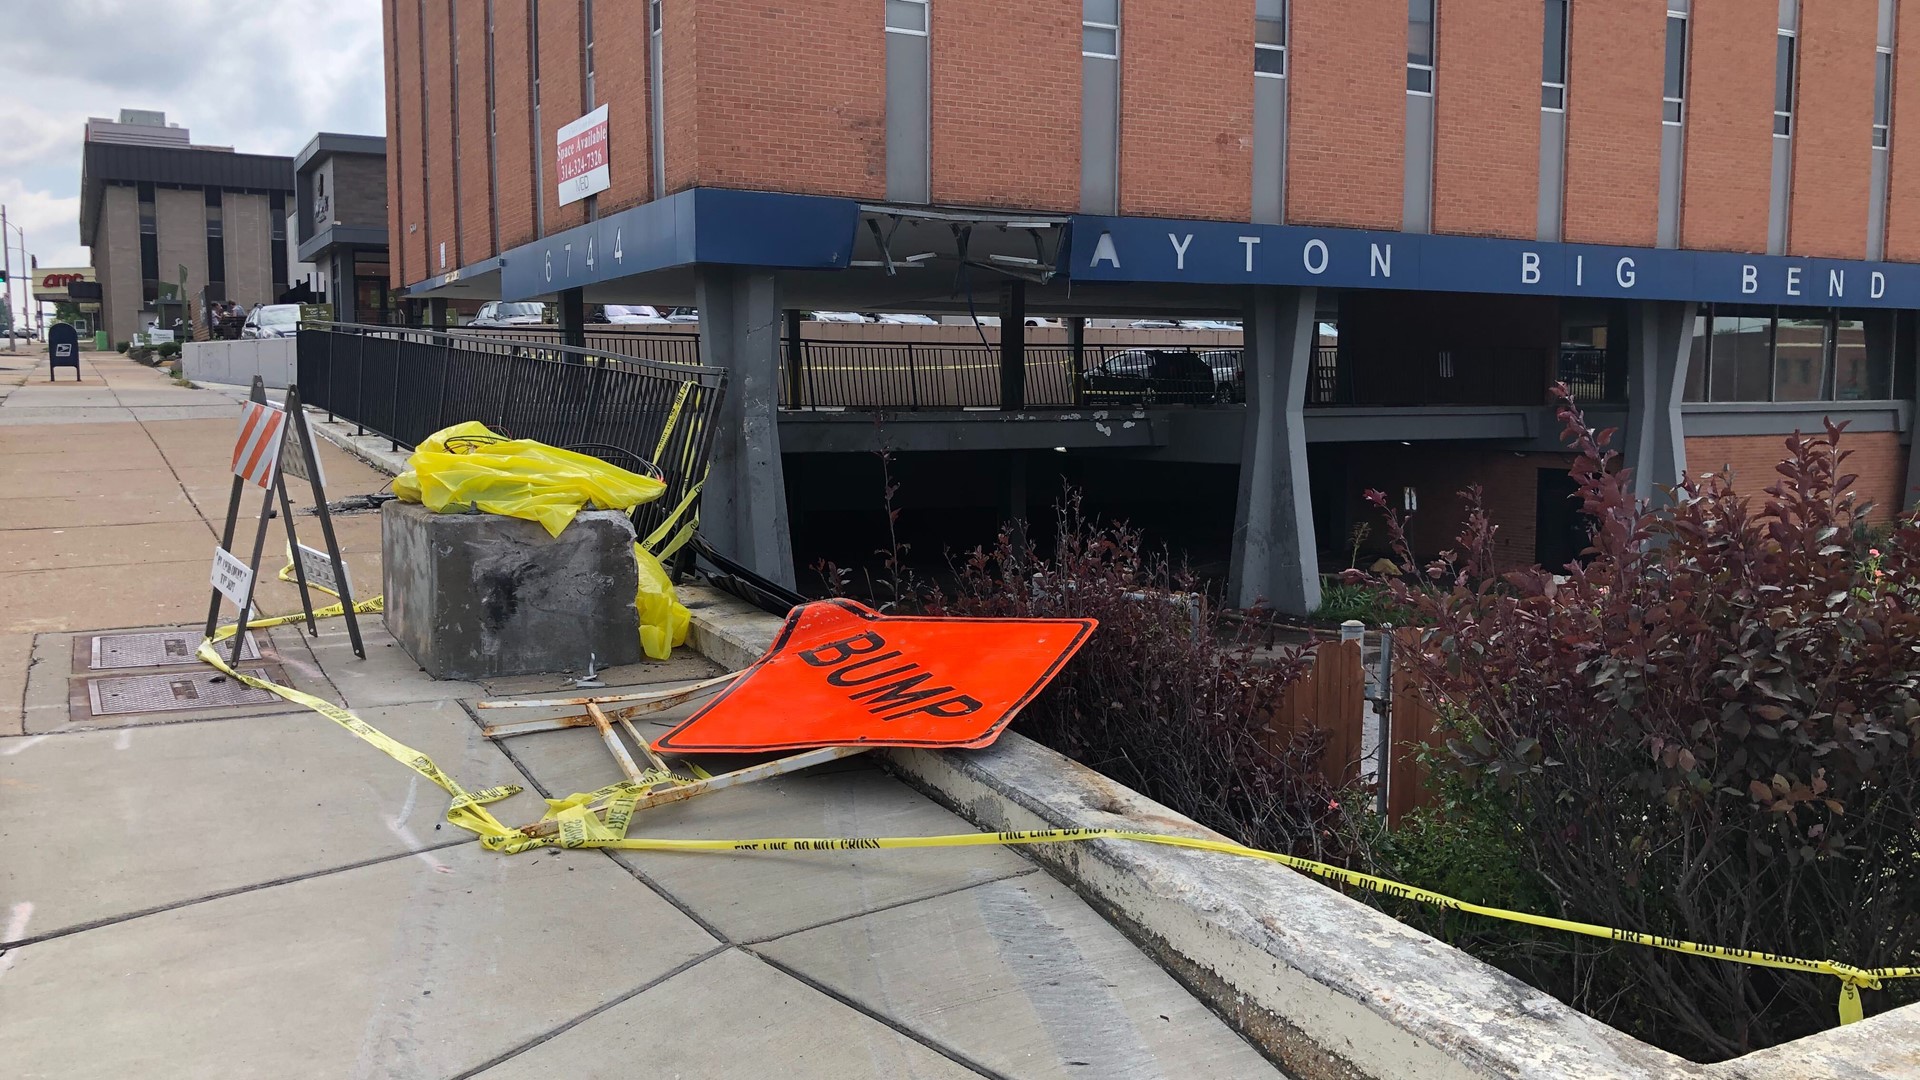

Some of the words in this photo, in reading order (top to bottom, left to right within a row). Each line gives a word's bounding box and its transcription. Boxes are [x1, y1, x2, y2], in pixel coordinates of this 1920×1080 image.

[557, 143, 575, 164] Space
[576, 124, 607, 153] Available
[560, 148, 603, 181] 314-324-7326
[545, 227, 623, 283] 6744
[1089, 230, 1392, 278] AYTON
[1521, 251, 1636, 288] BIG
[1741, 264, 1886, 300] BEND
[797, 630, 984, 722] BUMP
[840, 837, 881, 849] CROSS
[1358, 877, 1378, 891] DO
[1382, 883, 1411, 900] NOT
[1611, 926, 1645, 943] FIRE
[1652, 934, 1686, 949] LINE
